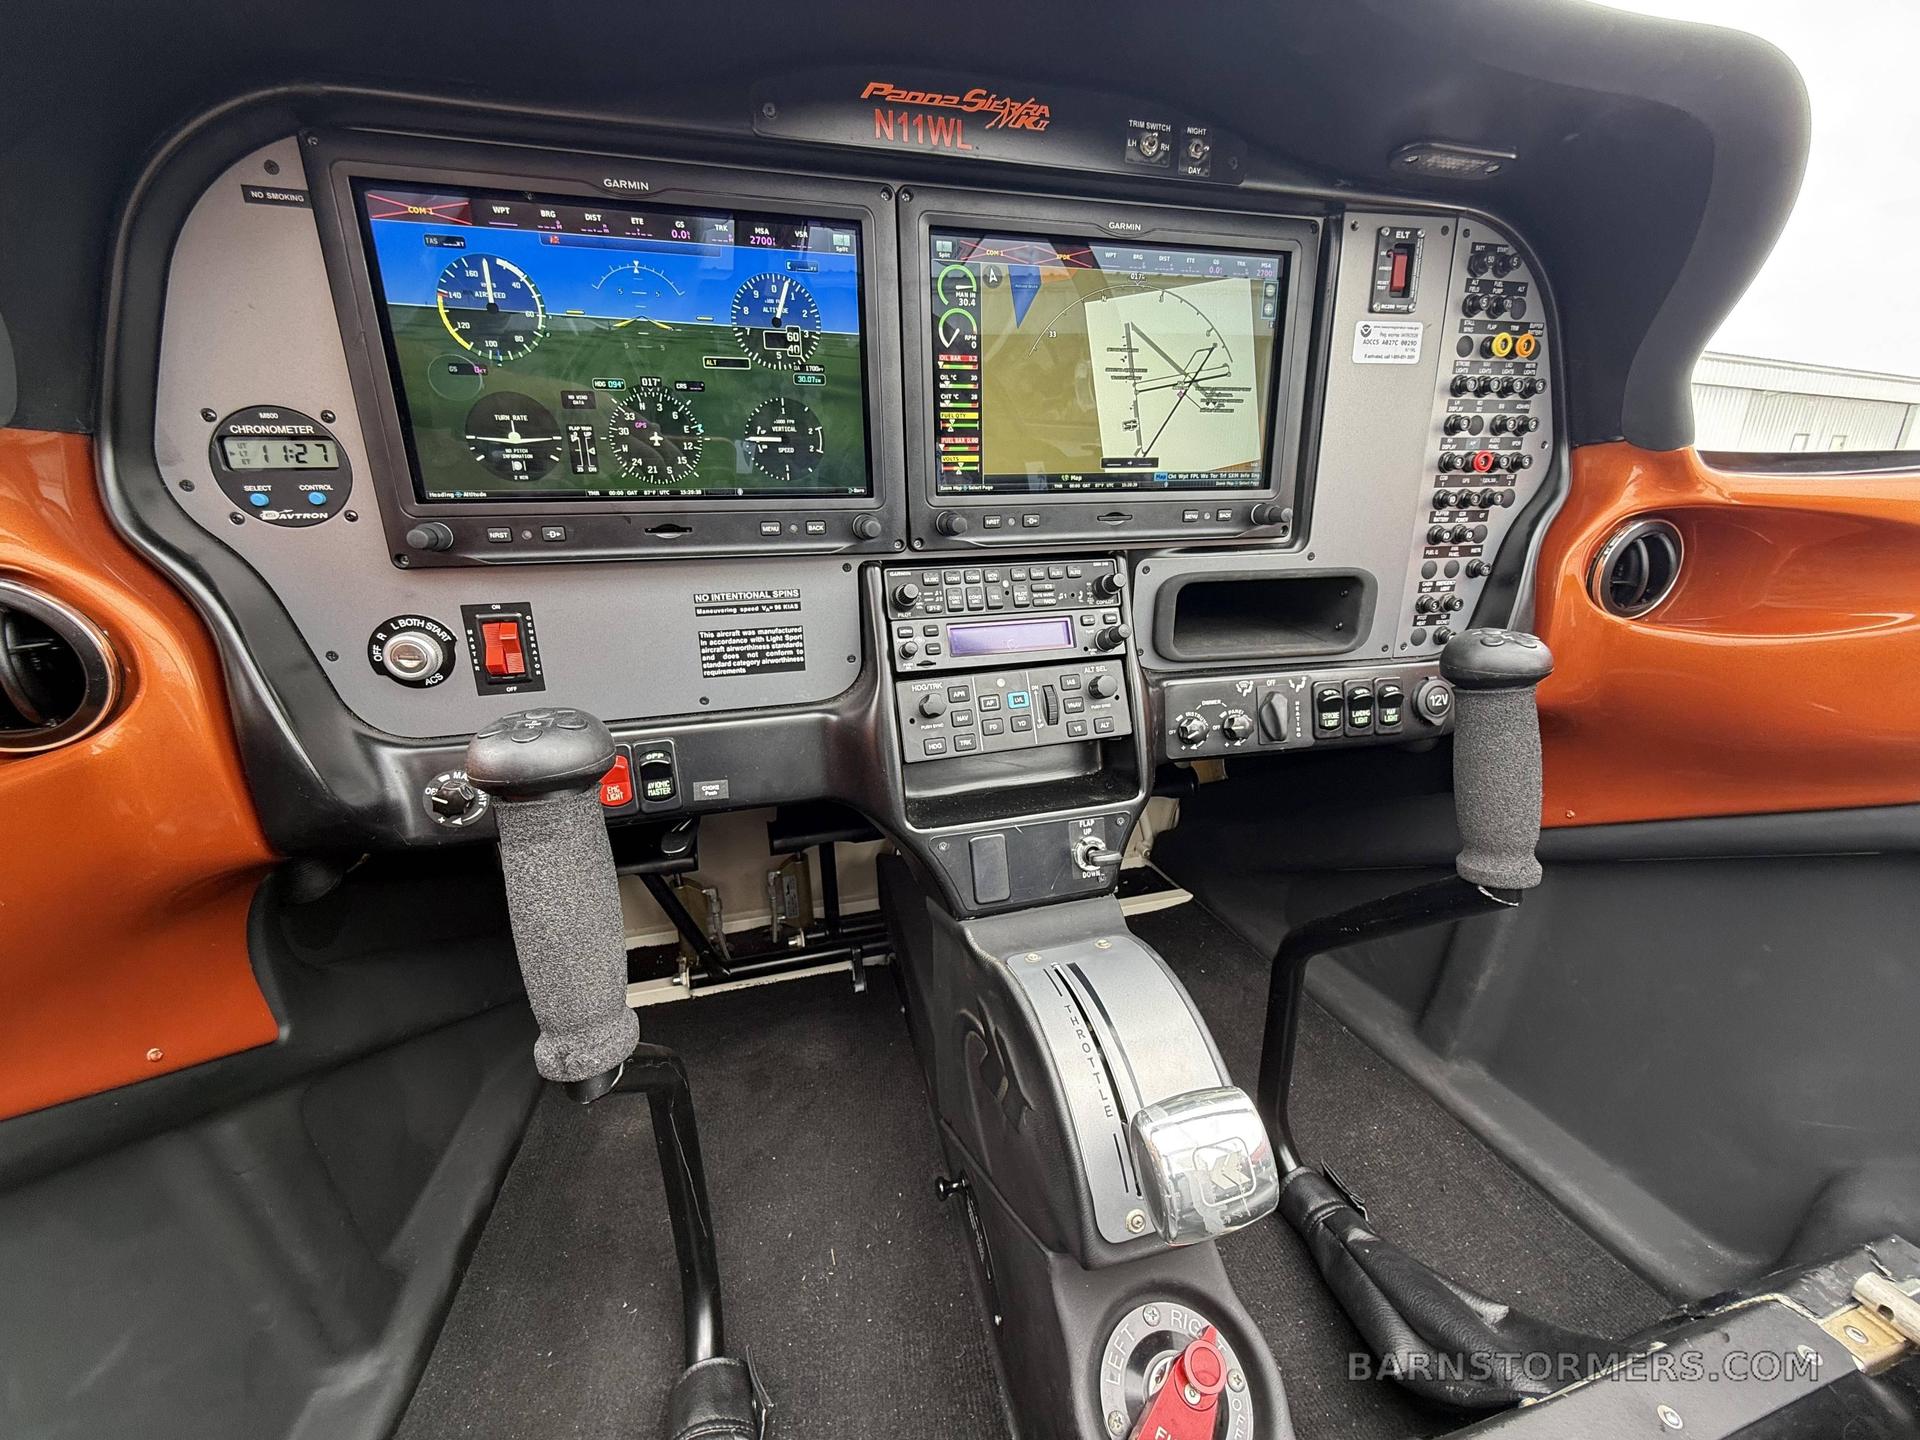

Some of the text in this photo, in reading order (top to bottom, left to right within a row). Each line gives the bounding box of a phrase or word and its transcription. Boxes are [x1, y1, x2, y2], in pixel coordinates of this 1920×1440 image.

[874, 108, 973, 150] N11WL
[1128, 120, 1171, 132] TRIM SWITCH
[1186, 127, 1207, 136] NIGHT
[1128, 139, 1170, 151] LH RH
[1188, 166, 1201, 175] DAY
[603, 178, 649, 191] GARMIN
[250, 190, 304, 202] NO SMOKING
[407, 206, 426, 214] COM
[492, 206, 510, 214] WPT
[540, 210, 556, 218] BRG
[584, 214, 602, 222] DIST
[631, 217, 644, 226] ETE
[675, 220, 684, 228] GS
[714, 224, 729, 232] TRK
[1108, 221, 1142, 231] GARMIN
[754, 228, 770, 236] MSA
[1396, 230, 1410, 238] ELT
[465, 270, 478, 278] 160
[958, 298, 976, 307] 30.4
[229, 424, 315, 435] CHRONOMETER
[683, 442, 694, 450] 12
[262, 443, 329, 464] 11:27
[260, 509, 329, 521] DAVTRON
[694, 589, 800, 602] NO INTENTIONAL SPINS
[696, 607, 738, 615] Maneuvering
[740, 605, 760, 613] speed
[390, 622, 400, 631] L
[398, 619, 425, 628] BOTH
[376, 632, 387, 641] R
[425, 622, 452, 643] START
[716, 630, 740, 638] aircraft
[757, 626, 803, 635] manufactured
[525, 615, 541, 675] GENERATOR
[709, 638, 748, 646] accordance
[466, 628, 480, 672] MASTER
[701, 641, 803, 654] aircraft airworthiness standards
[372, 644, 382, 662] OFF
[766, 649, 794, 657] conform
[702, 656, 805, 668] standard category airworthiness
[703, 667, 747, 677] requirements
[424, 672, 444, 686] ACS
[912, 682, 943, 692] HDG/TRK
[953, 690, 966, 698] APR
[1429, 694, 1448, 706] 12V
[1322, 712, 1340, 720] STROBE
[928, 742, 943, 750] HDG
[959, 738, 972, 746] TRK
[648, 780, 670, 790] AVIONIC
[606, 786, 620, 794] EMG
[648, 787, 672, 796] MASTER
[606, 792, 624, 802] LIGHT
[1079, 820, 1094, 828] FLAP
[1083, 828, 1092, 836] UP
[1064, 1004, 1114, 1119] THROTTLE
[1170, 1309, 1227, 1353] RIGT
[1105, 1323, 1136, 1386] LEFT
